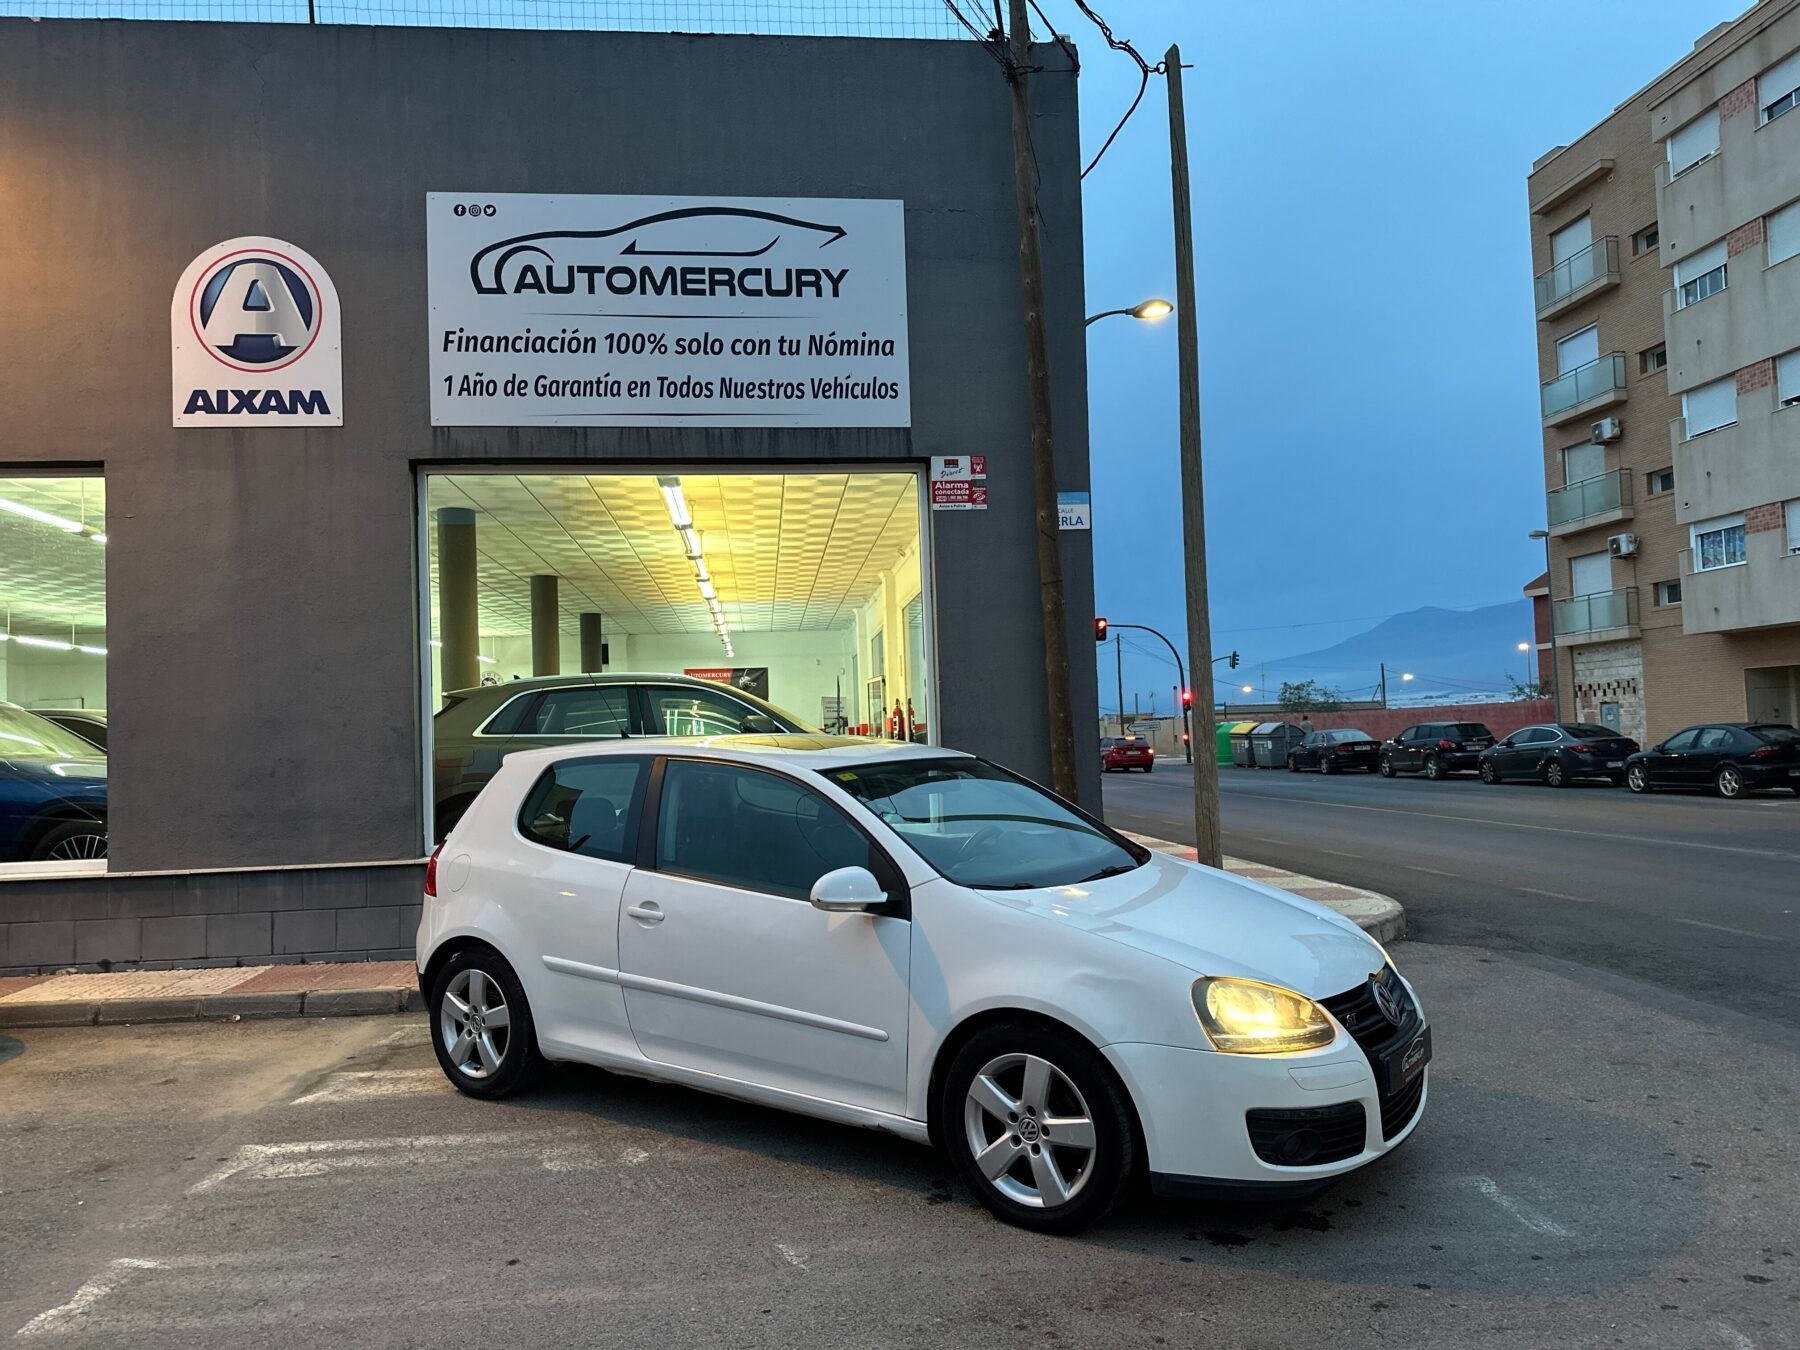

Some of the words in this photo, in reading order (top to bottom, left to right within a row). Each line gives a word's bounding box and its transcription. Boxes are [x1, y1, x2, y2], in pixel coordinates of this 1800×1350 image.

[513, 264, 849, 298] AUTOMERCURY
[443, 327, 597, 354] Financiación
[604, 332, 668, 356] 100%
[674, 331, 724, 356] solo
[730, 337, 771, 356] con
[778, 335, 801, 356] tu
[808, 331, 895, 356] Nómina
[443, 375, 453, 396] 1
[458, 372, 498, 397] Año
[503, 373, 528, 397] de
[534, 372, 622, 398] Garantía
[627, 379, 651, 398] en
[656, 374, 714, 399] Todos
[719, 376, 805, 400] Nuestros
[810, 374, 899, 399] Vehículos
[183, 390, 331, 415] AIXAM
[935, 481, 969, 489] Alarma
[1058, 515, 1084, 526] RLA
